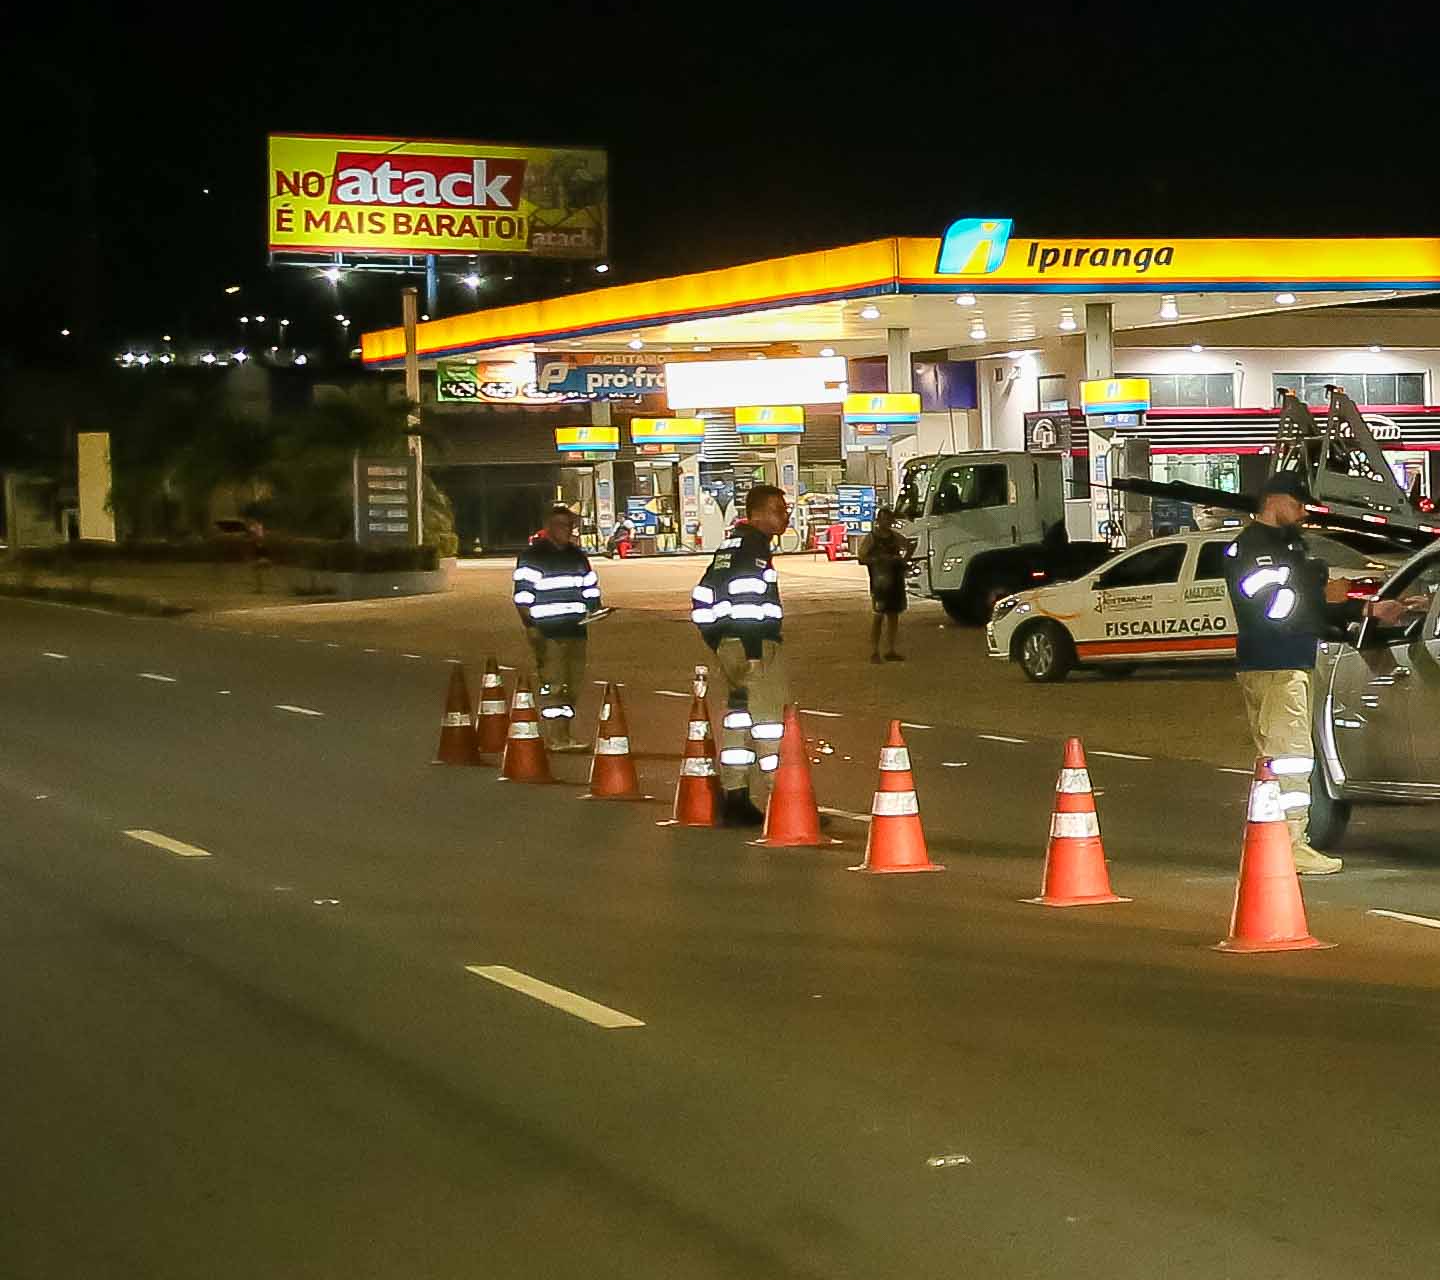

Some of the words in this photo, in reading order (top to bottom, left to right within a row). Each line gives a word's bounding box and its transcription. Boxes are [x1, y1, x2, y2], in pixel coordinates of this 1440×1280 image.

[275, 170, 325, 198] NO
[335, 159, 512, 207] atack
[275, 203, 294, 233] É
[304, 209, 386, 234] MAIS
[393, 214, 526, 240] BARATO!
[1027, 242, 1174, 273] Ipiranga
[1105, 614, 1227, 637] FISCALIZAÇÃO
